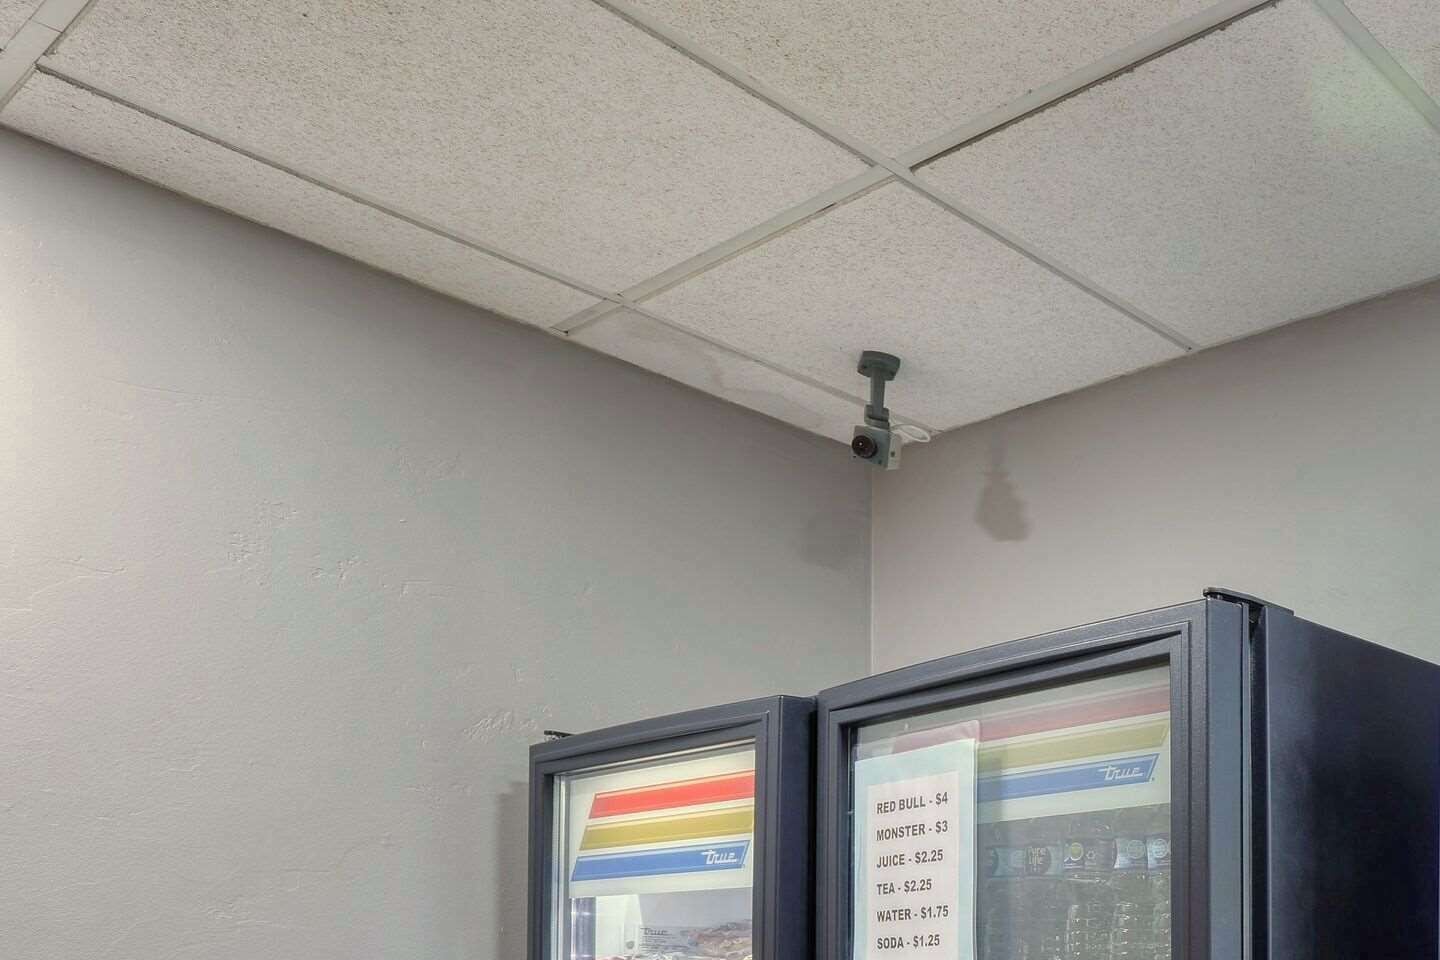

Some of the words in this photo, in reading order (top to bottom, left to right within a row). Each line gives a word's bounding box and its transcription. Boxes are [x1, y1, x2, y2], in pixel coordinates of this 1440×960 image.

[877, 801, 896, 814] RED
[899, 796, 926, 811] BULL
[935, 792, 948, 806] $4
[876, 824, 926, 840] MONSTER
[935, 820, 948, 834] $3
[876, 854, 905, 868] JUICE
[915, 849, 943, 864] $2.25
[877, 882, 895, 895] TEA
[904, 878, 932, 893] $2.25
[877, 909, 911, 922] WATER
[921, 905, 949, 919] $1.75
[877, 936, 904, 949] SODA
[913, 934, 940, 948] $1.25
